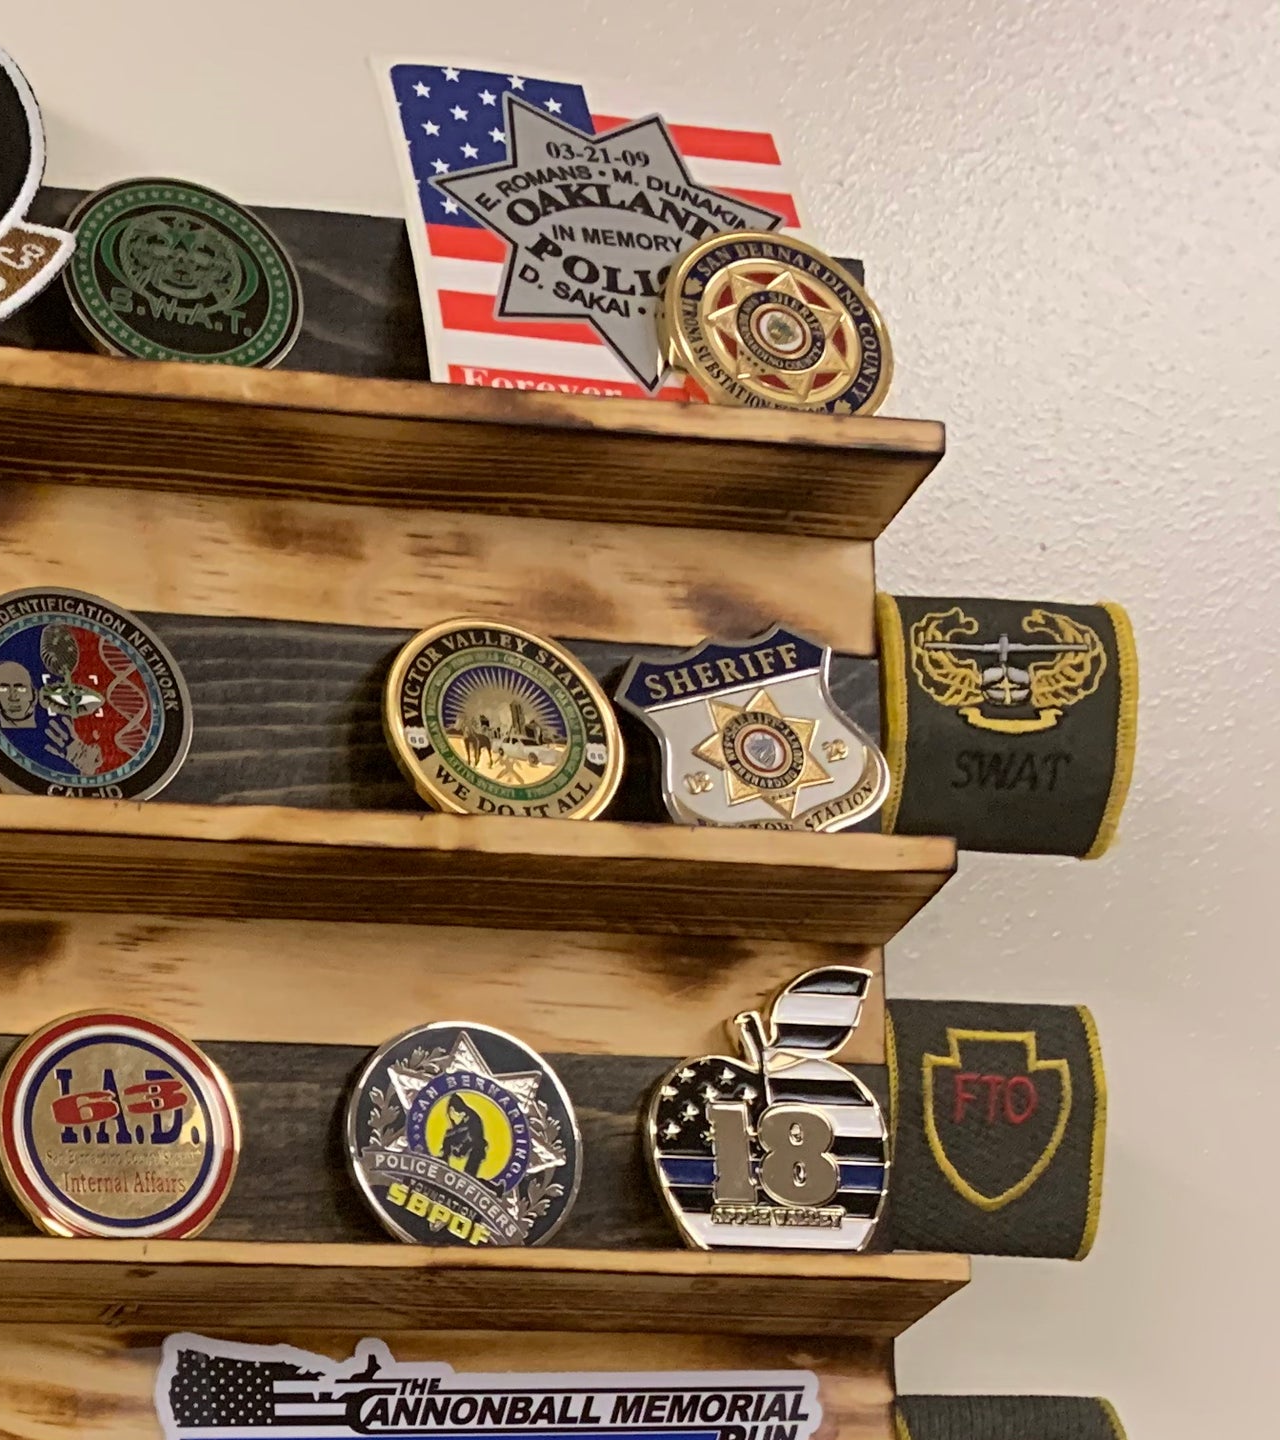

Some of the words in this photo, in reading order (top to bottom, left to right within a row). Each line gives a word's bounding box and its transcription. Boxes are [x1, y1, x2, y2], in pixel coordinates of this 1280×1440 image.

[546, 140, 651, 168] 03-21-09
[552, 224, 576, 242] IN
[584, 229, 684, 253] MEMORY
[519, 264, 544, 289] D.
[553, 283, 631, 318] SAKAI
[697, 249, 731, 277] SAN
[740, 243, 864, 318] BERNARDINO
[851, 322, 880, 400] COUNTY
[128, 628, 179, 712] NETWORK
[404, 647, 443, 721] VICTOR
[441, 631, 529, 654] VALLEY
[535, 649, 604, 737] STATION
[644, 642, 798, 700] SHERIFF
[951, 751, 1072, 791] SWAT
[804, 780, 874, 832] STATION
[51, 1078, 189, 1125] 63
[953, 1072, 1038, 1124] FTO
[705, 1100, 840, 1207] 18
[63, 1171, 127, 1193] Internal
[133, 1171, 186, 1193] Affairs
[376, 1153, 438, 1178] POLICE
[444, 1171, 518, 1238] OFFICERS
[345, 1387, 602, 1432] CANNONBALL
[609, 1393, 809, 1425] MEMORIAL
[397, 1378, 441, 1395] THE
